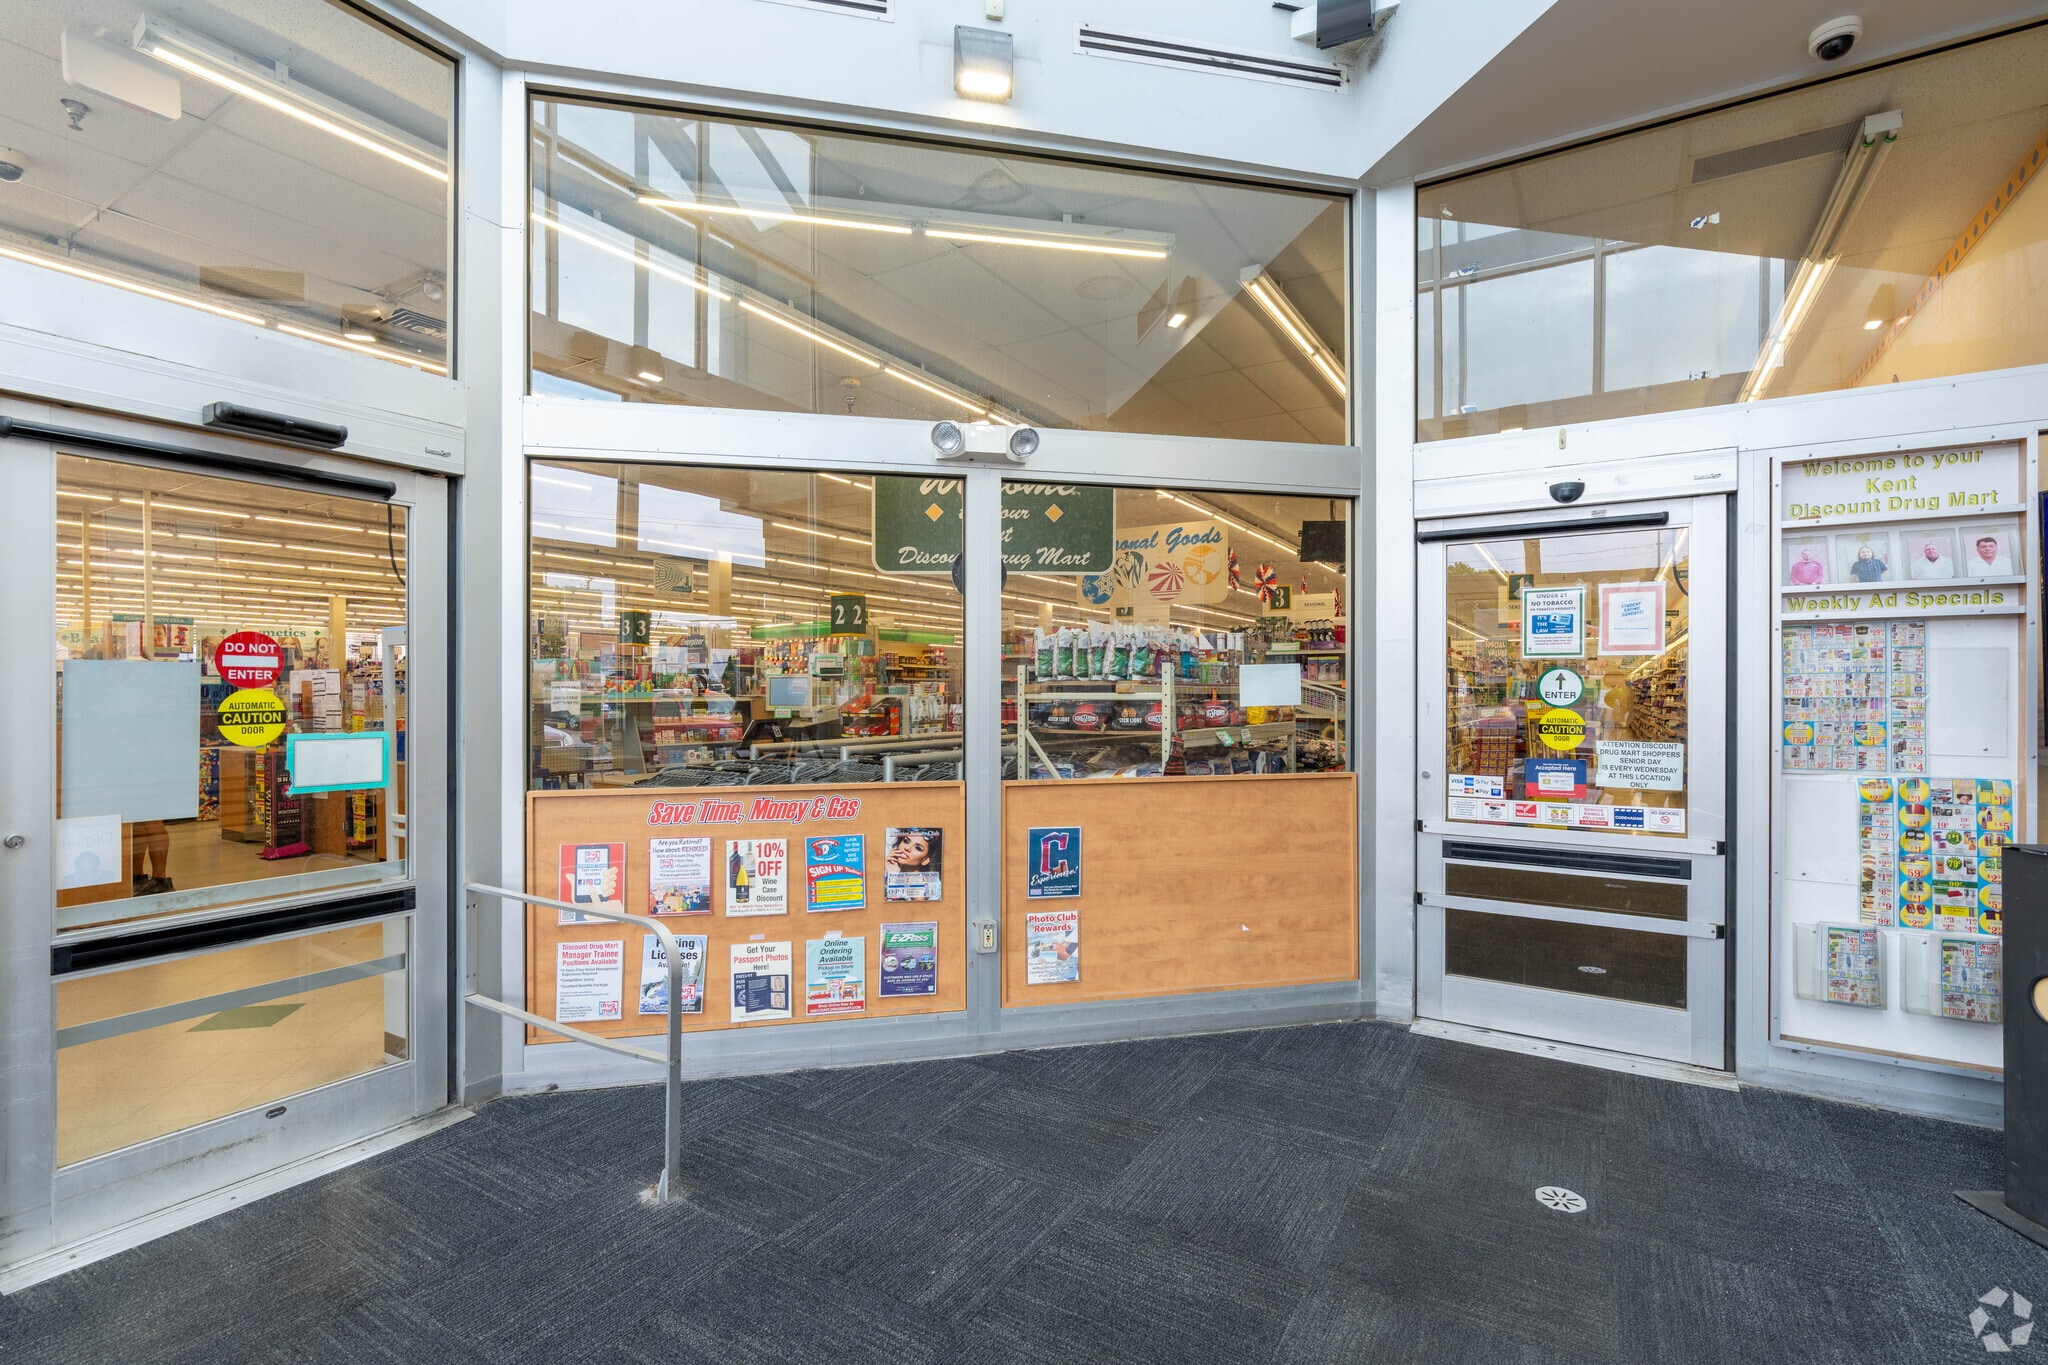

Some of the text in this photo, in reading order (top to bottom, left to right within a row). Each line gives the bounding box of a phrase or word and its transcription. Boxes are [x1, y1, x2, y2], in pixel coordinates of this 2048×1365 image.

[1803, 450, 1984, 478] Welcome to your
[1866, 475, 1917, 494] Kent
[1789, 490, 1998, 519] Discount Drug Mart
[1001, 506, 1030, 520] our
[1165, 526, 1223, 554] Goods
[898, 546, 1091, 570] Discou rug Mart
[1275, 588, 1285, 608] 3
[1788, 589, 2004, 612] Weekly Ad Specials
[835, 605, 845, 625] 2
[852, 605, 863, 625] 2
[622, 619, 630, 636] 3
[636, 620, 646, 637] 3
[224, 642, 276, 654] DO NOT
[681, 638, 704, 647] Energizer
[1485, 641, 1505, 649] SPECIAL
[1488, 648, 1507, 657] VALUES
[228, 669, 273, 681] ENTER
[228, 701, 276, 710] AUTOMATIC
[222, 712, 282, 725] CAUTION
[1074, 715, 1096, 723] KINGSFORD
[241, 726, 264, 735] DOOR
[1541, 725, 1583, 734] CAUTION
[278, 801, 299, 809] PINK
[649, 797, 860, 824] Save Time, Money & Gas
[756, 842, 784, 858] 10%
[758, 861, 782, 876] OFF
[809, 866, 832, 877] SIGN
[1031, 866, 1078, 886] Experience!
[1029, 913, 1076, 923] Photo Club
[1034, 924, 1072, 932] Rewards
[890, 933, 930, 942] E-ZPass
[589, 943, 603, 951] Drug
[656, 939, 695, 950] Fing
[562, 950, 619, 960] Manager Trainee
[651, 950, 698, 960] Licses
[734, 954, 788, 964] Passport Photos
